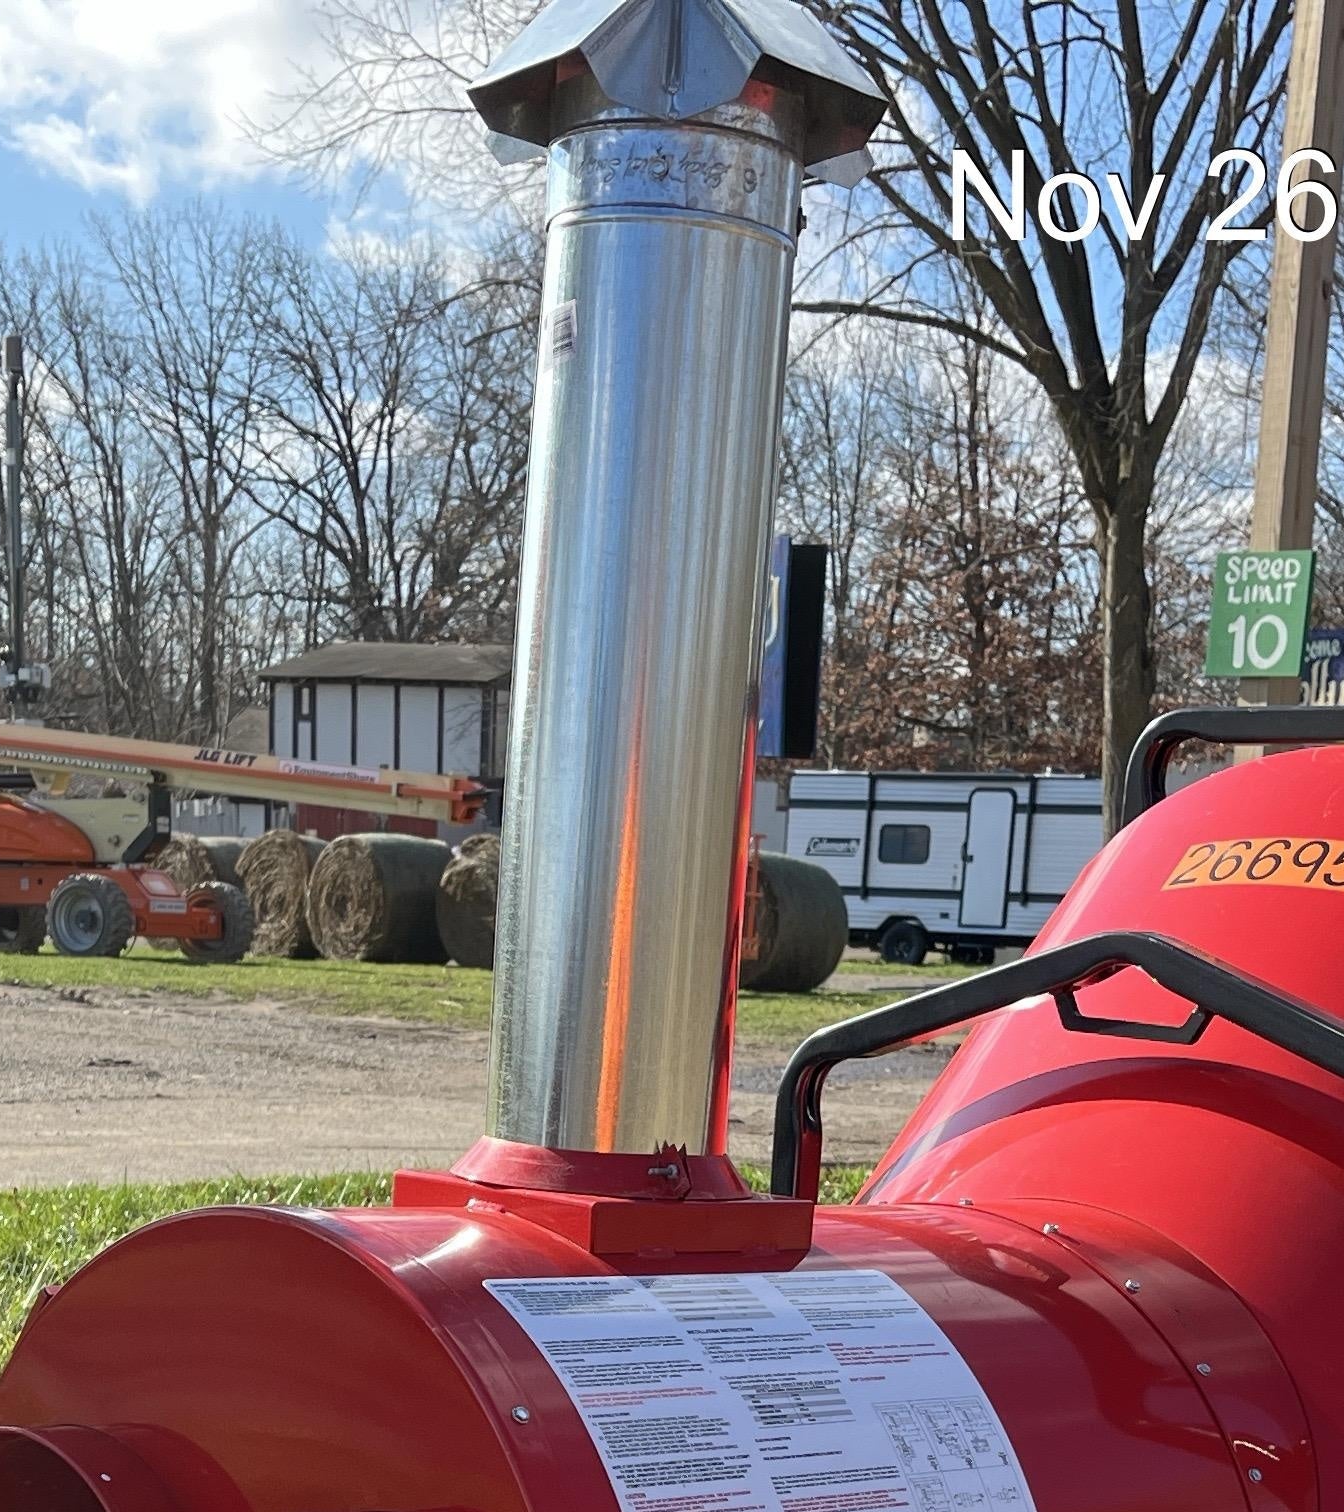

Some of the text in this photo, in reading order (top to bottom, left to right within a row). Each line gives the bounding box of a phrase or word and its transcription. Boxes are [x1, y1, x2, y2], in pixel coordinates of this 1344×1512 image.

[1227, 613, 1288, 670] 10
[194, 749, 258, 767] JLG LIFT
